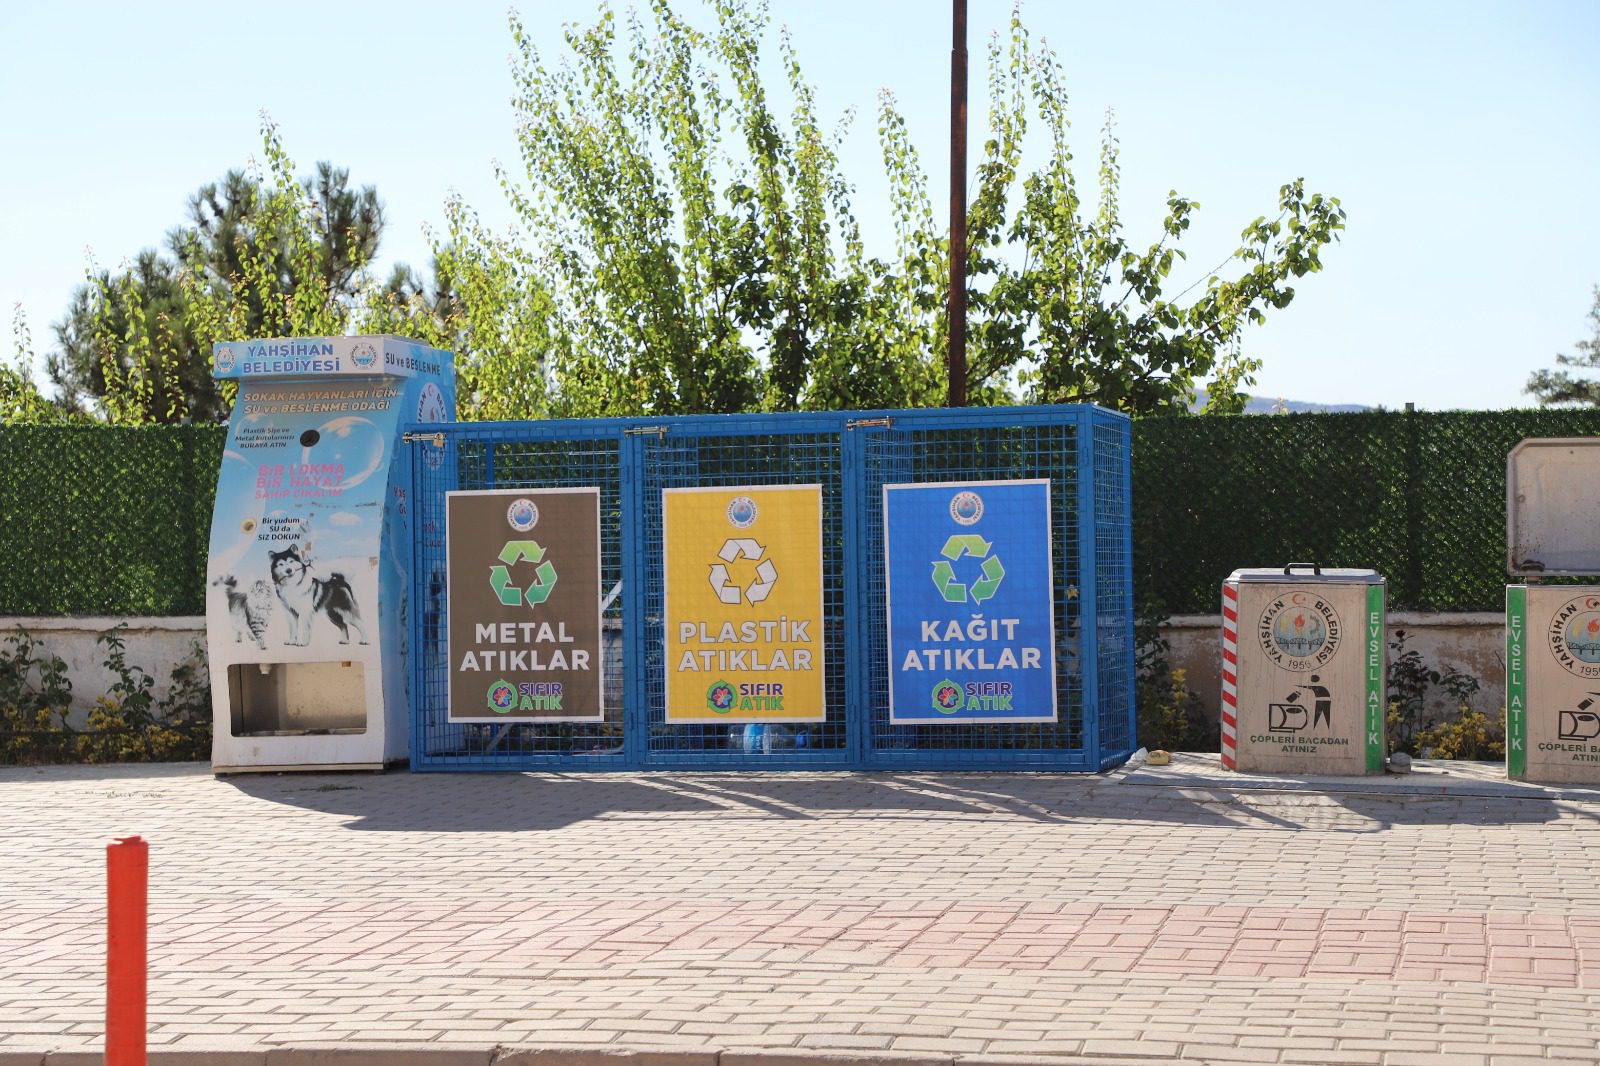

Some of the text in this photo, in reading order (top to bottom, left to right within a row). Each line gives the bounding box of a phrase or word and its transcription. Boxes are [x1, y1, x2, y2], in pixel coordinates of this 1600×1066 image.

[248, 342, 334, 357] YAHŞİHAN
[243, 357, 340, 373] BELEDİYESİ
[385, 352, 441, 376] SU ve BESLENME
[243, 392, 285, 402] SOKAK
[288, 390, 369, 401] HAYVANLARI
[243, 400, 390, 414] SU ve BESLENME ODAĞI
[289, 463, 345, 476] LOKMA
[289, 475, 343, 488] HAYAT
[274, 517, 300, 525] yudum
[475, 622, 575, 644] METAL
[679, 616, 812, 644] PLASTİK
[921, 613, 1020, 642] KAĞIT
[1260, 600, 1285, 664] YAHŞİHAN
[1314, 600, 1339, 665] BELEDİYESİ
[1550, 604, 1577, 669] YAHŞİHAN
[460, 650, 590, 672] ATIKLAR
[677, 649, 813, 673] ATIKLAR
[902, 647, 1041, 671] ATIKLAR
[1368, 612, 1379, 745] EVSEL ATIK
[1580, 667, 1600, 677] 195
[519, 682, 563, 696] SIFIR
[740, 683, 783, 696] SIFIR
[965, 682, 1012, 696] SIFIR
[1511, 615, 1522, 751] EVSEL ATIK
[519, 695, 563, 711] ATIK
[740, 695, 785, 711] ATIK
[966, 695, 1014, 711] ATIK
[1298, 736, 1349, 745] BACADAN
[1538, 742, 1587, 752] ÇÖPLERİ
[1281, 745, 1317, 753] ATINIZ
[1572, 753, 1600, 762] ATIN
